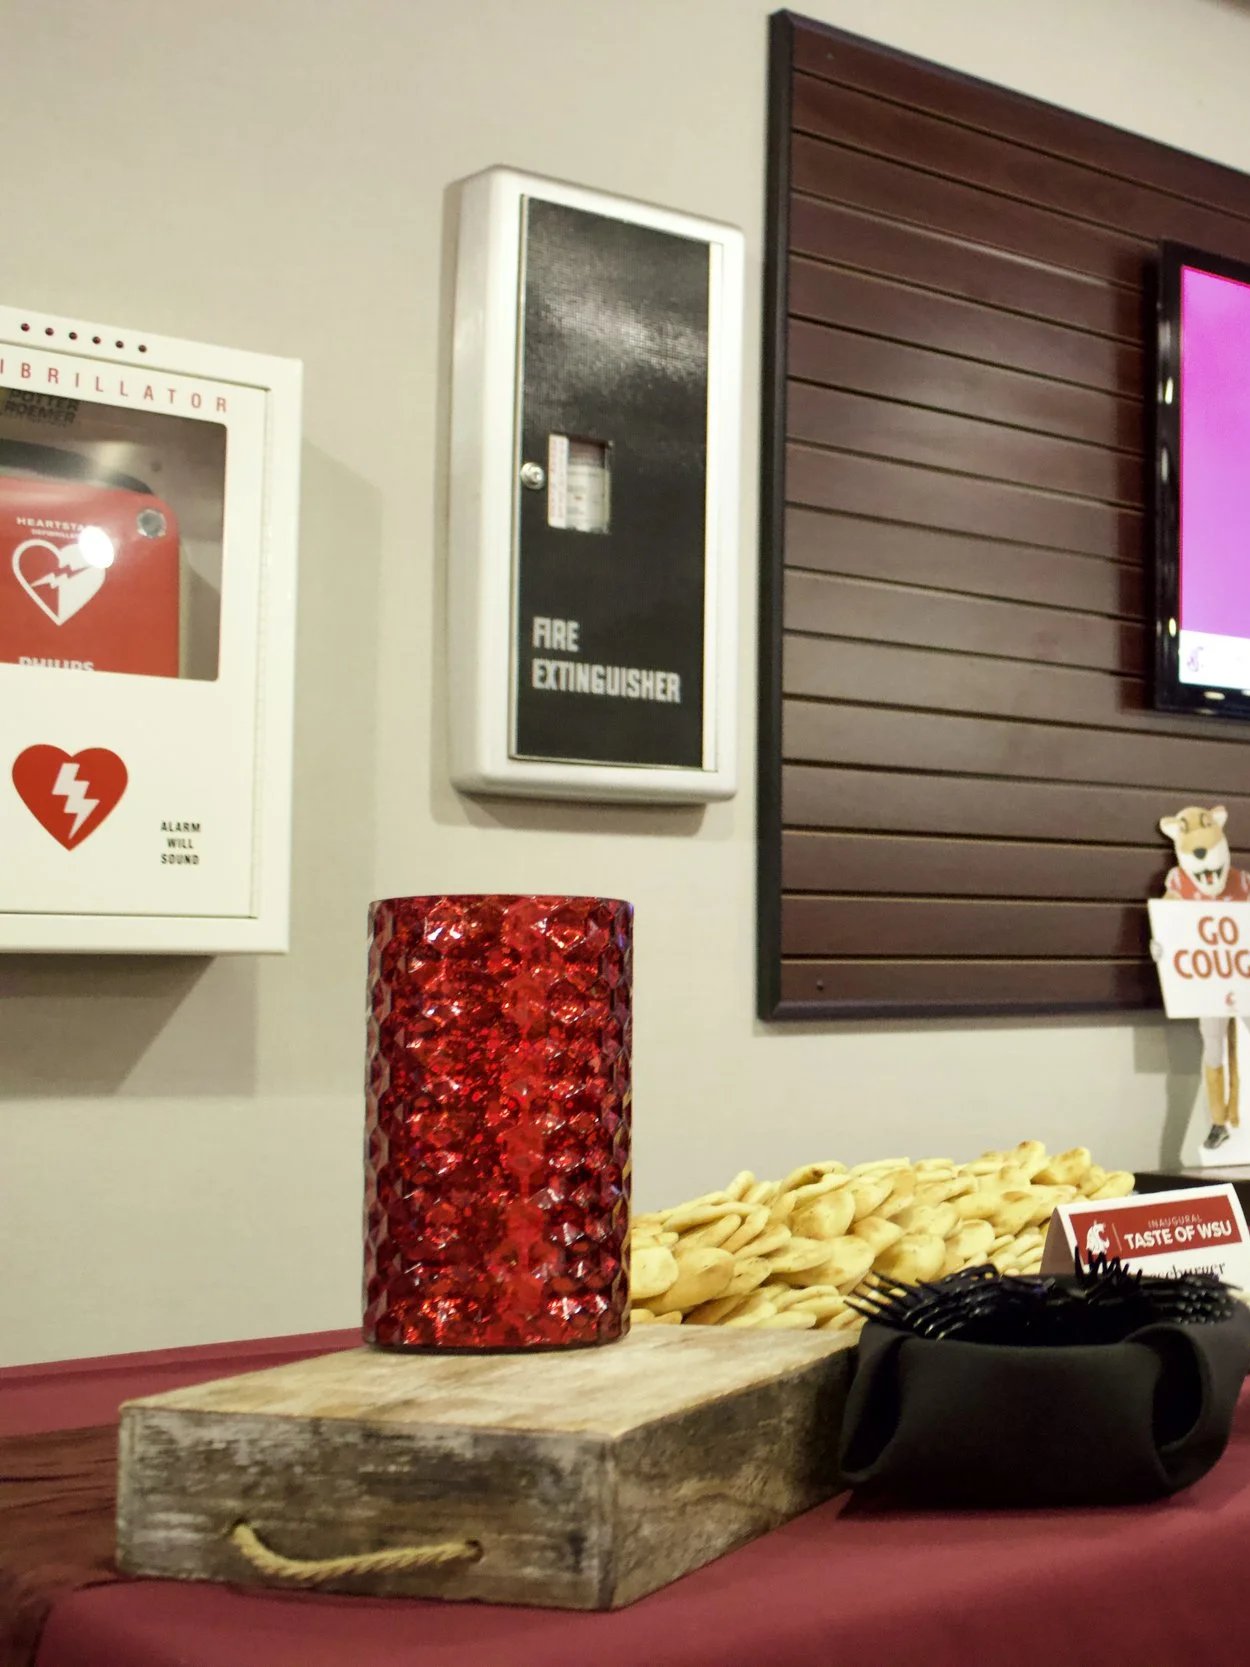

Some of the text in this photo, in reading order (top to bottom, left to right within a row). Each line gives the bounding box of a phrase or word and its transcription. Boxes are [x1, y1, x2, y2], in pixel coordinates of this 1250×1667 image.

[533, 617, 578, 651] FIRE
[532, 658, 681, 703] EXTINGUISHER
[161, 821, 200, 833] ALARM
[167, 838, 194, 849] WILL
[161, 854, 199, 865] SOUND
[1197, 916, 1239, 946] GO
[1147, 1213, 1203, 1228] INAUGURAL
[1123, 1219, 1233, 1251] TASTE OF WSU
